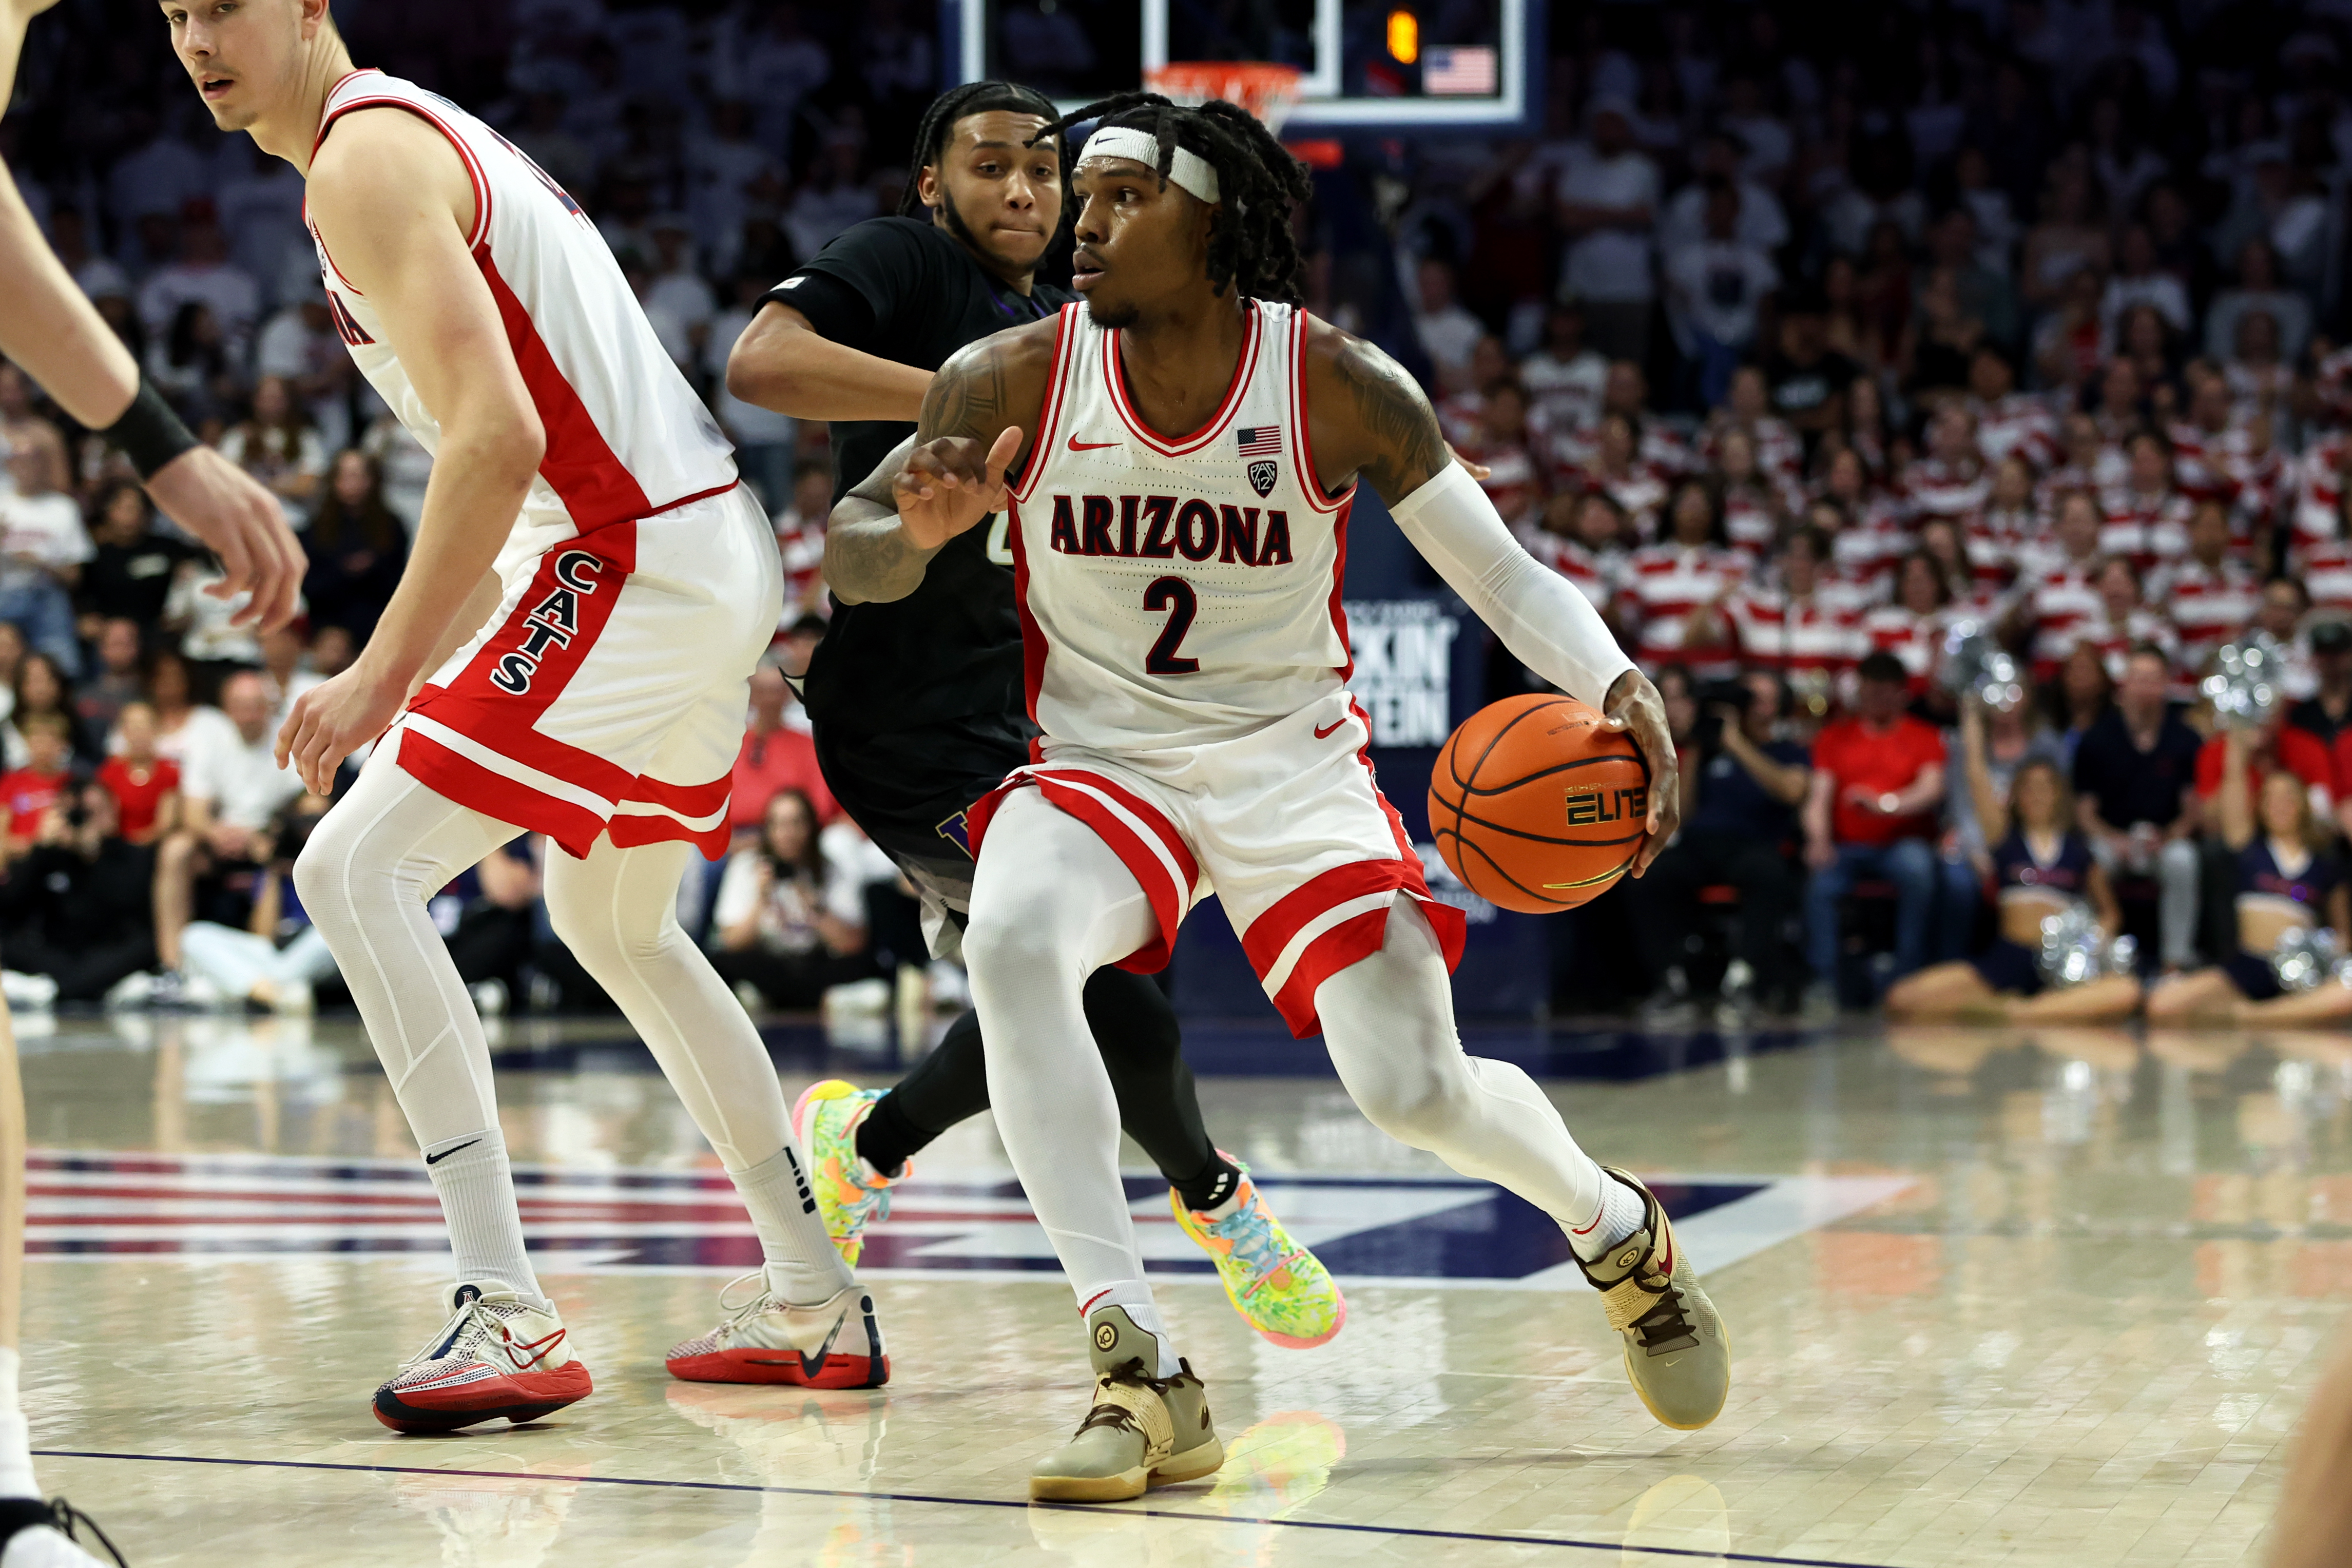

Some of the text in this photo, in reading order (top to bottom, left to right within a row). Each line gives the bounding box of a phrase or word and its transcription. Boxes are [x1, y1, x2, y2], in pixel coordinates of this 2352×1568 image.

[1250, 462, 1276, 484] PAC
[1257, 476, 1270, 490] 12
[1051, 495, 1293, 567] ARIZONA
[489, 550, 604, 695] CATS
[1143, 576, 1200, 674] 2
[1566, 786, 1647, 826] ELITE
